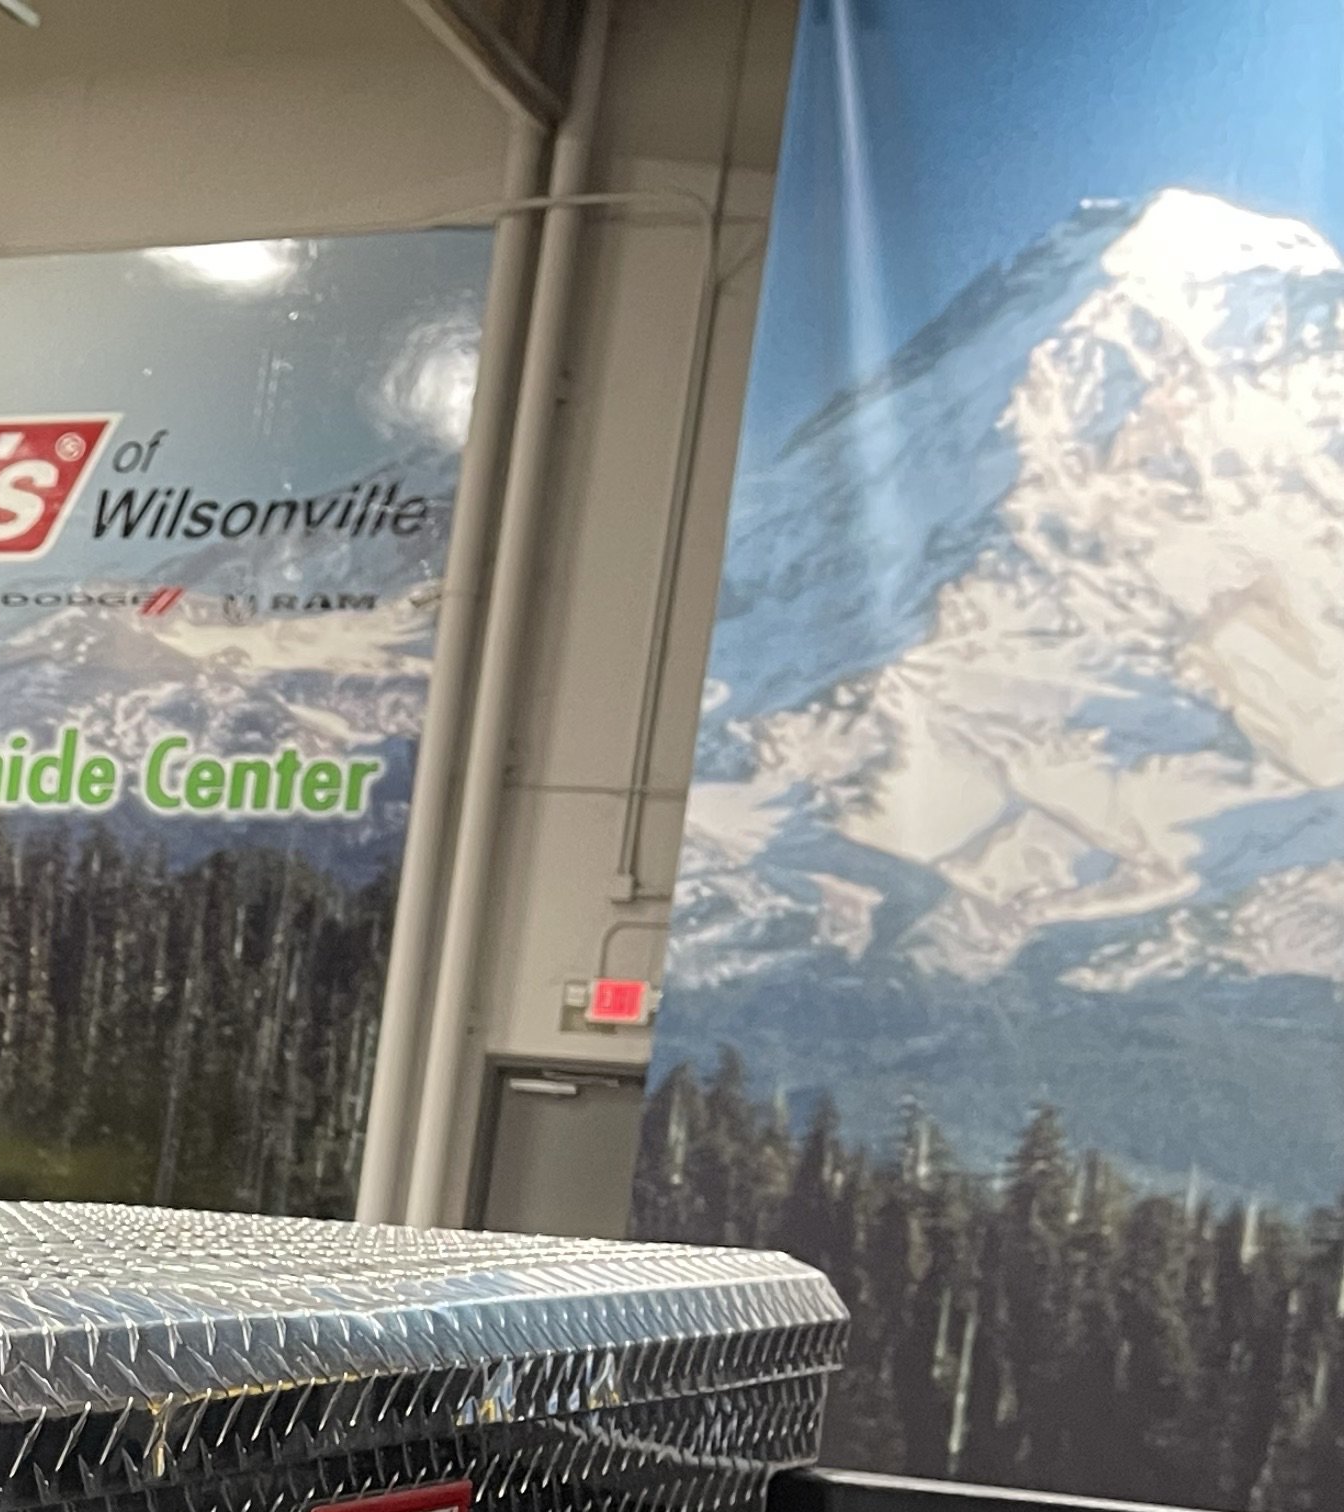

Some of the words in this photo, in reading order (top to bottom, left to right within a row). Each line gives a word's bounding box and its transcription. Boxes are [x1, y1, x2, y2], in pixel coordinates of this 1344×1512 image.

[112, 429, 169, 474] of
[92, 482, 429, 540] Wilsonville
[1, 591, 151, 608] DODGE
[270, 593, 378, 610] RAM
[144, 736, 379, 813] Center
